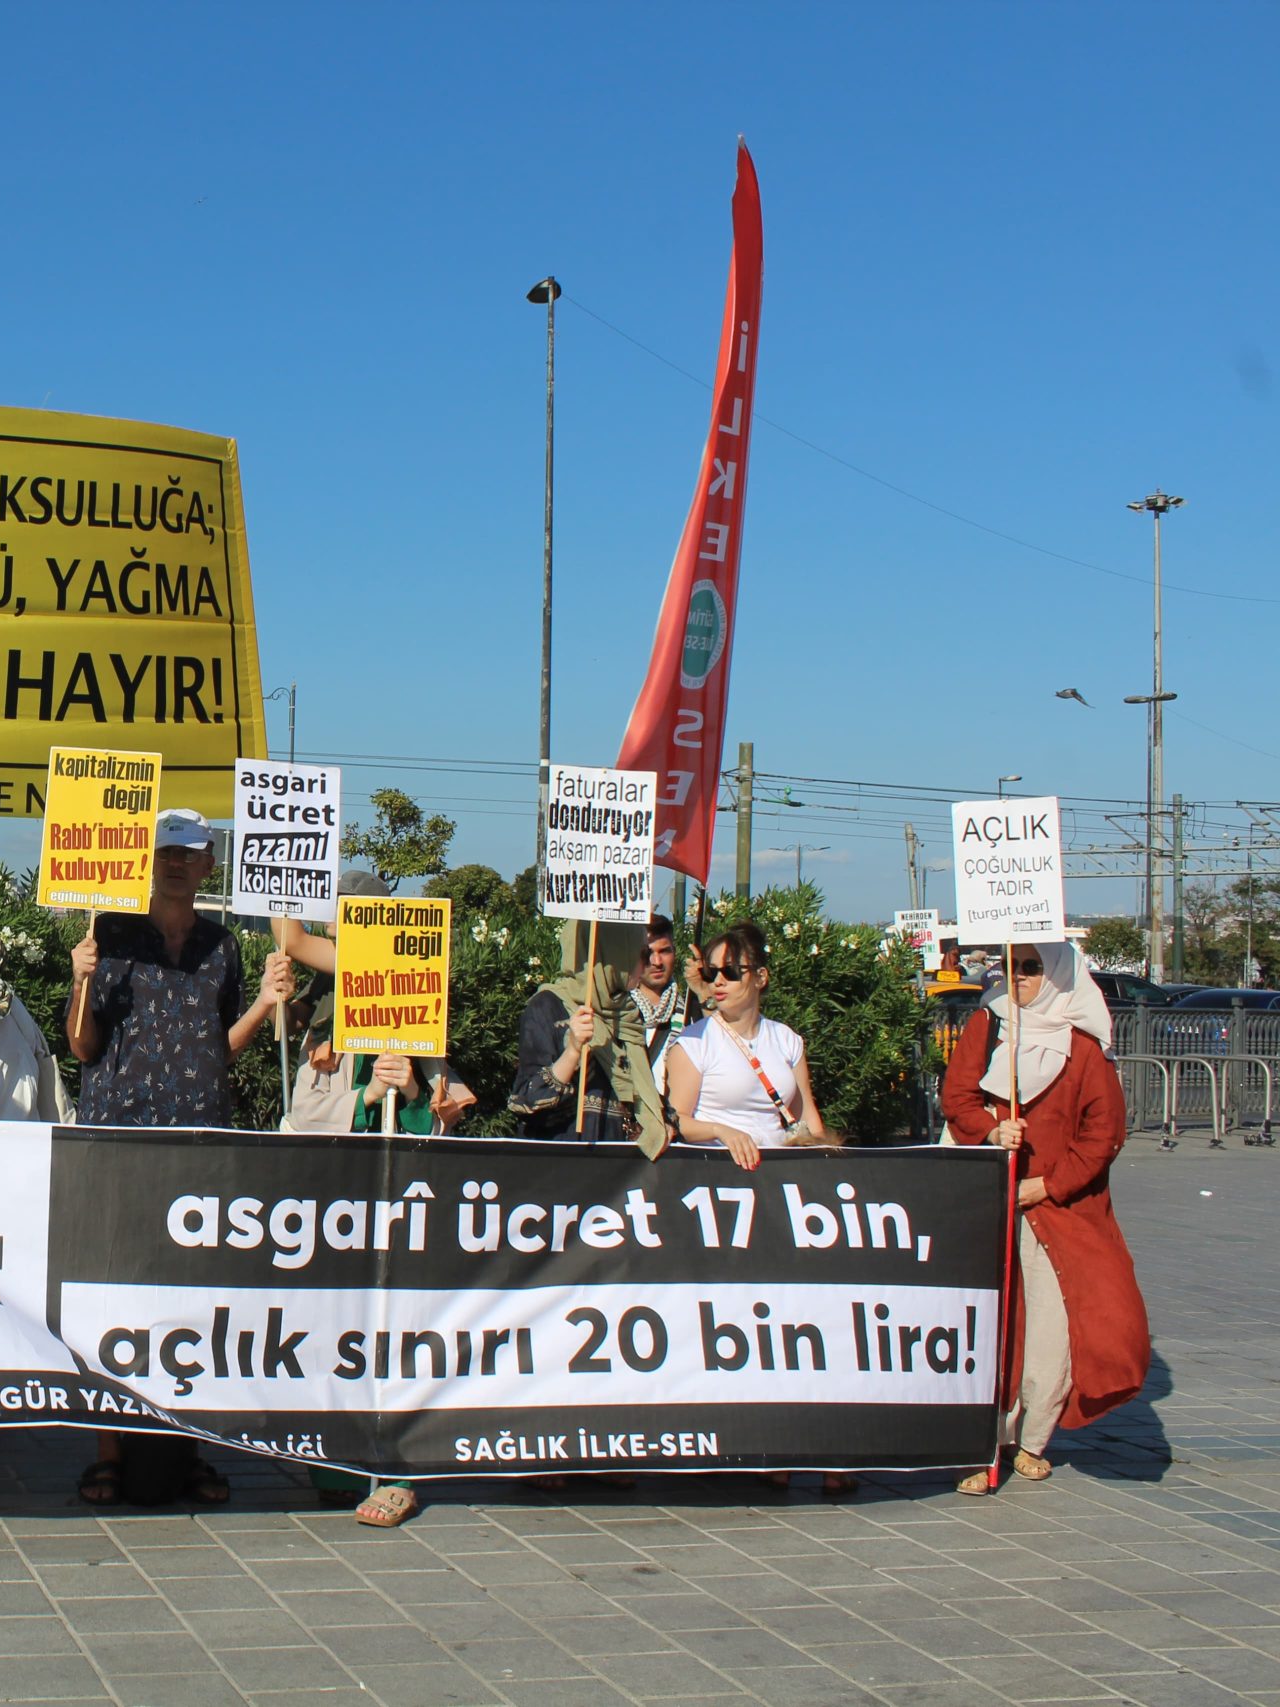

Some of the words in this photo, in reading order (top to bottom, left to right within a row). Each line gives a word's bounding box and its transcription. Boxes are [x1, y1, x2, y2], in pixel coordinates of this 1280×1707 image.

[47, 547, 222, 617] YAĞMA
[5, 649, 224, 724] HAYIR!
[55, 753, 155, 782] kapitalizmin
[240, 770, 327, 795] asgari
[103, 784, 151, 815] değil
[556, 771, 648, 802] faturalar
[247, 795, 335, 826] ücret
[549, 798, 653, 843] donduruyor
[50, 823, 149, 851] Rabb'imizin
[962, 814, 1049, 848] AÇLIK
[549, 835, 598, 865] akşam
[603, 846, 651, 868] pazarı
[964, 855, 1053, 878] ÇOĞUNLUK
[240, 865, 330, 899] köleliktir!
[987, 880, 1033, 896] TADIR
[50, 890, 86, 905] eğitim
[90, 891, 138, 908] ilke-sen
[270, 902, 302, 914] tokad
[968, 906, 1012, 923] [turgut
[1016, 900, 1049, 916] uyar]
[343, 902, 443, 928] kapitalizmin
[394, 930, 442, 960] değil
[343, 968, 441, 998] Rabb'imizin
[345, 1037, 382, 1051] eğitim
[386, 1037, 434, 1053] ilke-sen
[167, 1181, 435, 1270] asgarî
[458, 1180, 659, 1253] ücret
[682, 1186, 756, 1249] 17
[785, 1183, 932, 1261] bin,
[98, 1305, 309, 1396] açlık
[333, 1318, 532, 1379] sınırı
[566, 1307, 669, 1373] 20
[700, 1301, 824, 1372] bin
[856, 1303, 976, 1375] lira!
[455, 1427, 568, 1461] SAĞLIK
[578, 1429, 717, 1458] İLKE-SEN
